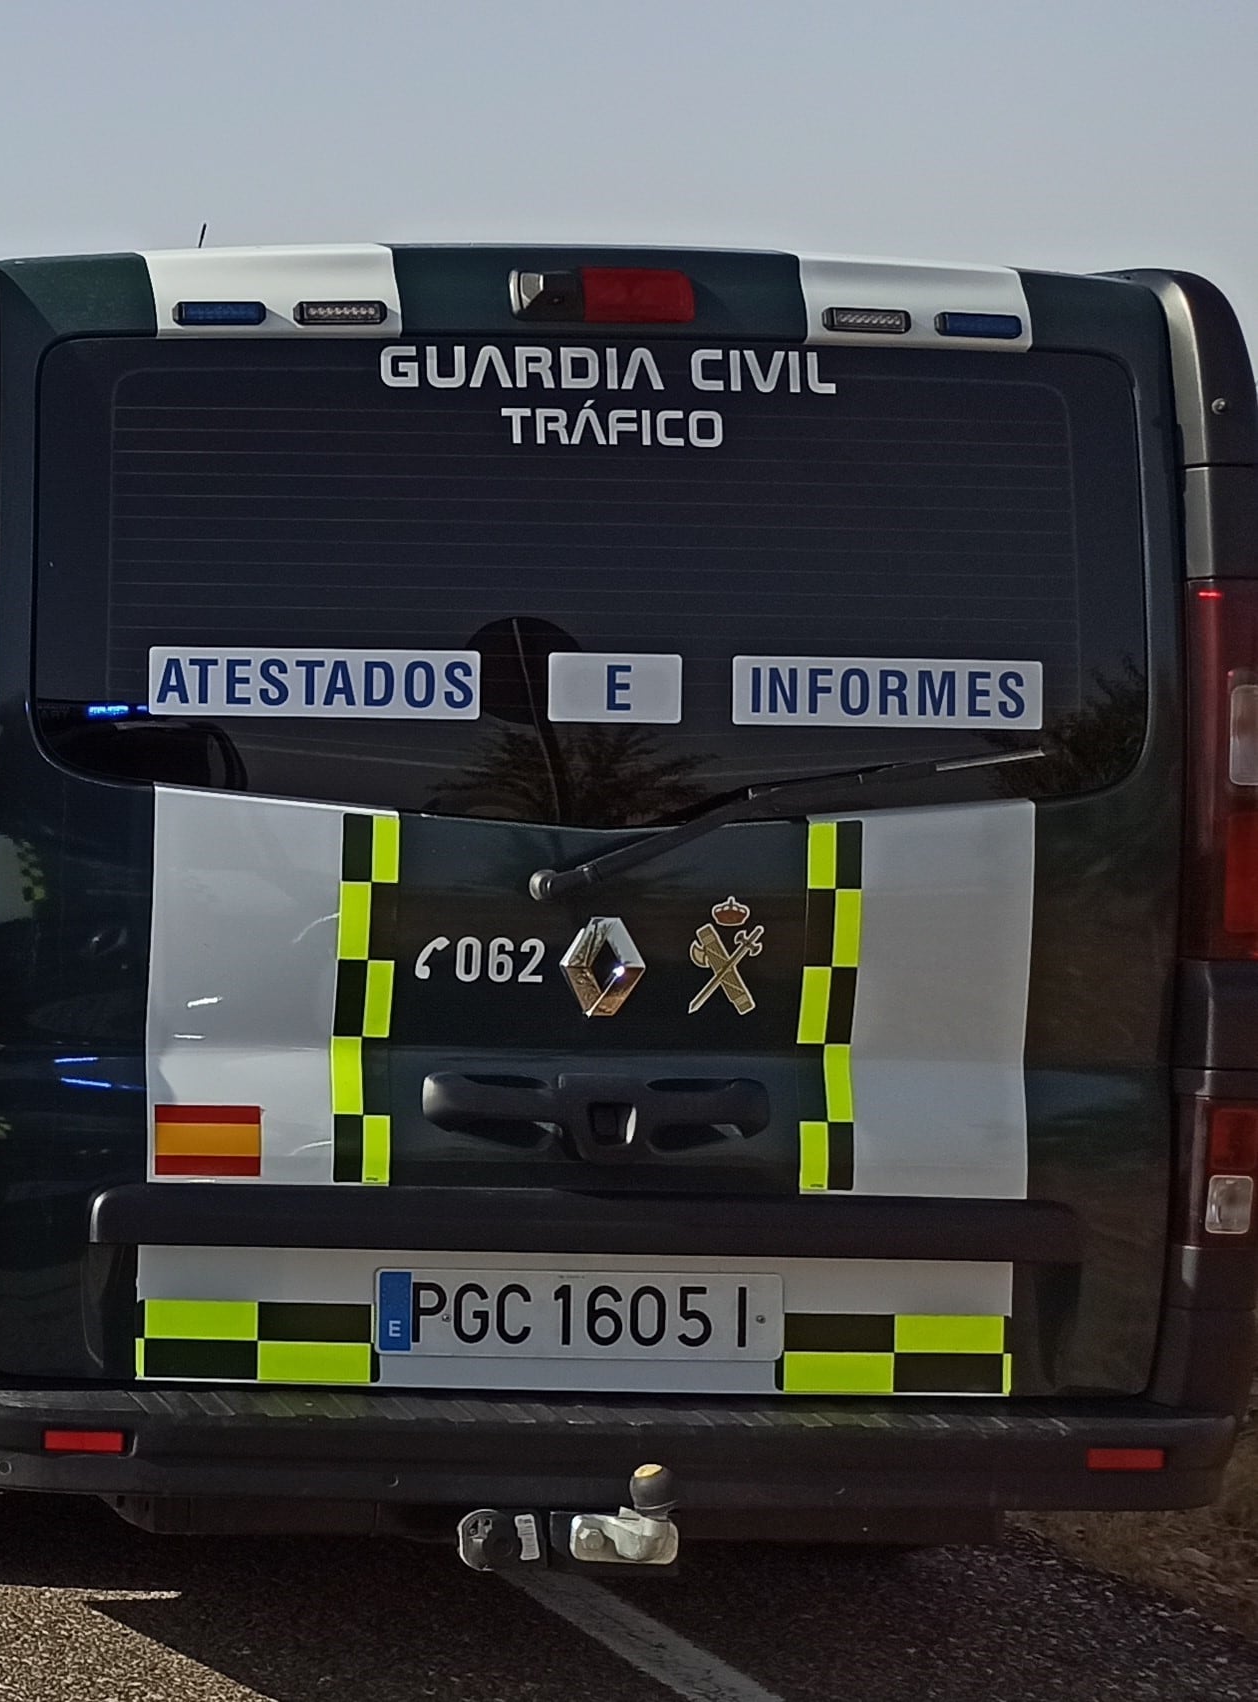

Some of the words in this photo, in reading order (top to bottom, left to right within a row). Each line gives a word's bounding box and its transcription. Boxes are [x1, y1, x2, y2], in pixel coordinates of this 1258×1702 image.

[380, 345, 665, 390] GUARDIA
[690, 349, 837, 394] CIVIL
[501, 400, 723, 448] TRÁFICO
[156, 657, 475, 710] ATESTADOS
[606, 665, 632, 711] E
[750, 666, 1027, 719] INFORMES
[455, 936, 545, 983] 062
[411, 1281, 532, 1345] PGC
[553, 1284, 712, 1348] 1605
